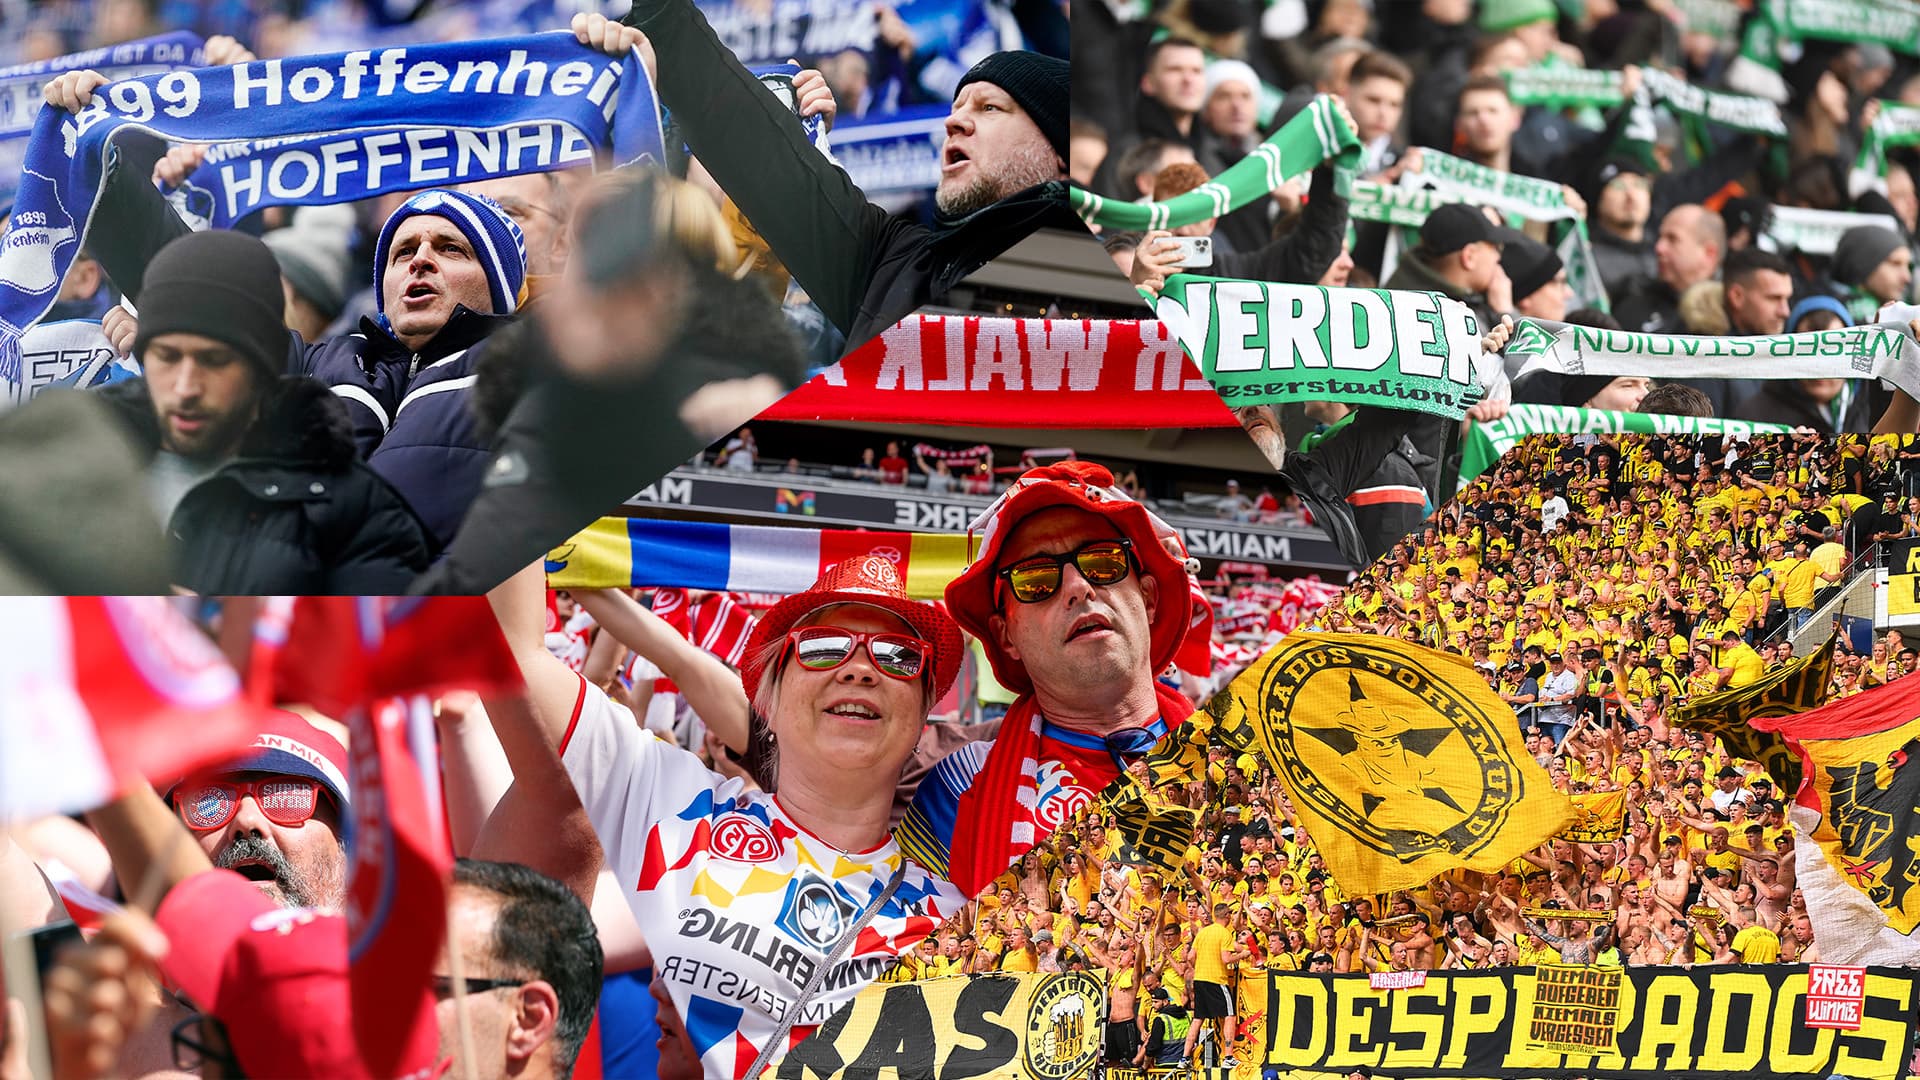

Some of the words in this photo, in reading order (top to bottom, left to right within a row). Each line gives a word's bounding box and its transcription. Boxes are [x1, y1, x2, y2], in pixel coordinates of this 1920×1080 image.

[61, 71, 201, 160] 1899
[15, 211, 47, 226] 1899
[1210, 376, 1456, 407] eserstadion
[290, 744, 325, 770] MIA
[1537, 968, 1621, 987] NIEMALS
[1810, 968, 1863, 996] FREE
[1535, 983, 1619, 1007] AUFGEBEN
[1533, 1006, 1616, 1026] NIEMALS
[1529, 1021, 1613, 1047] VERGESSEN
